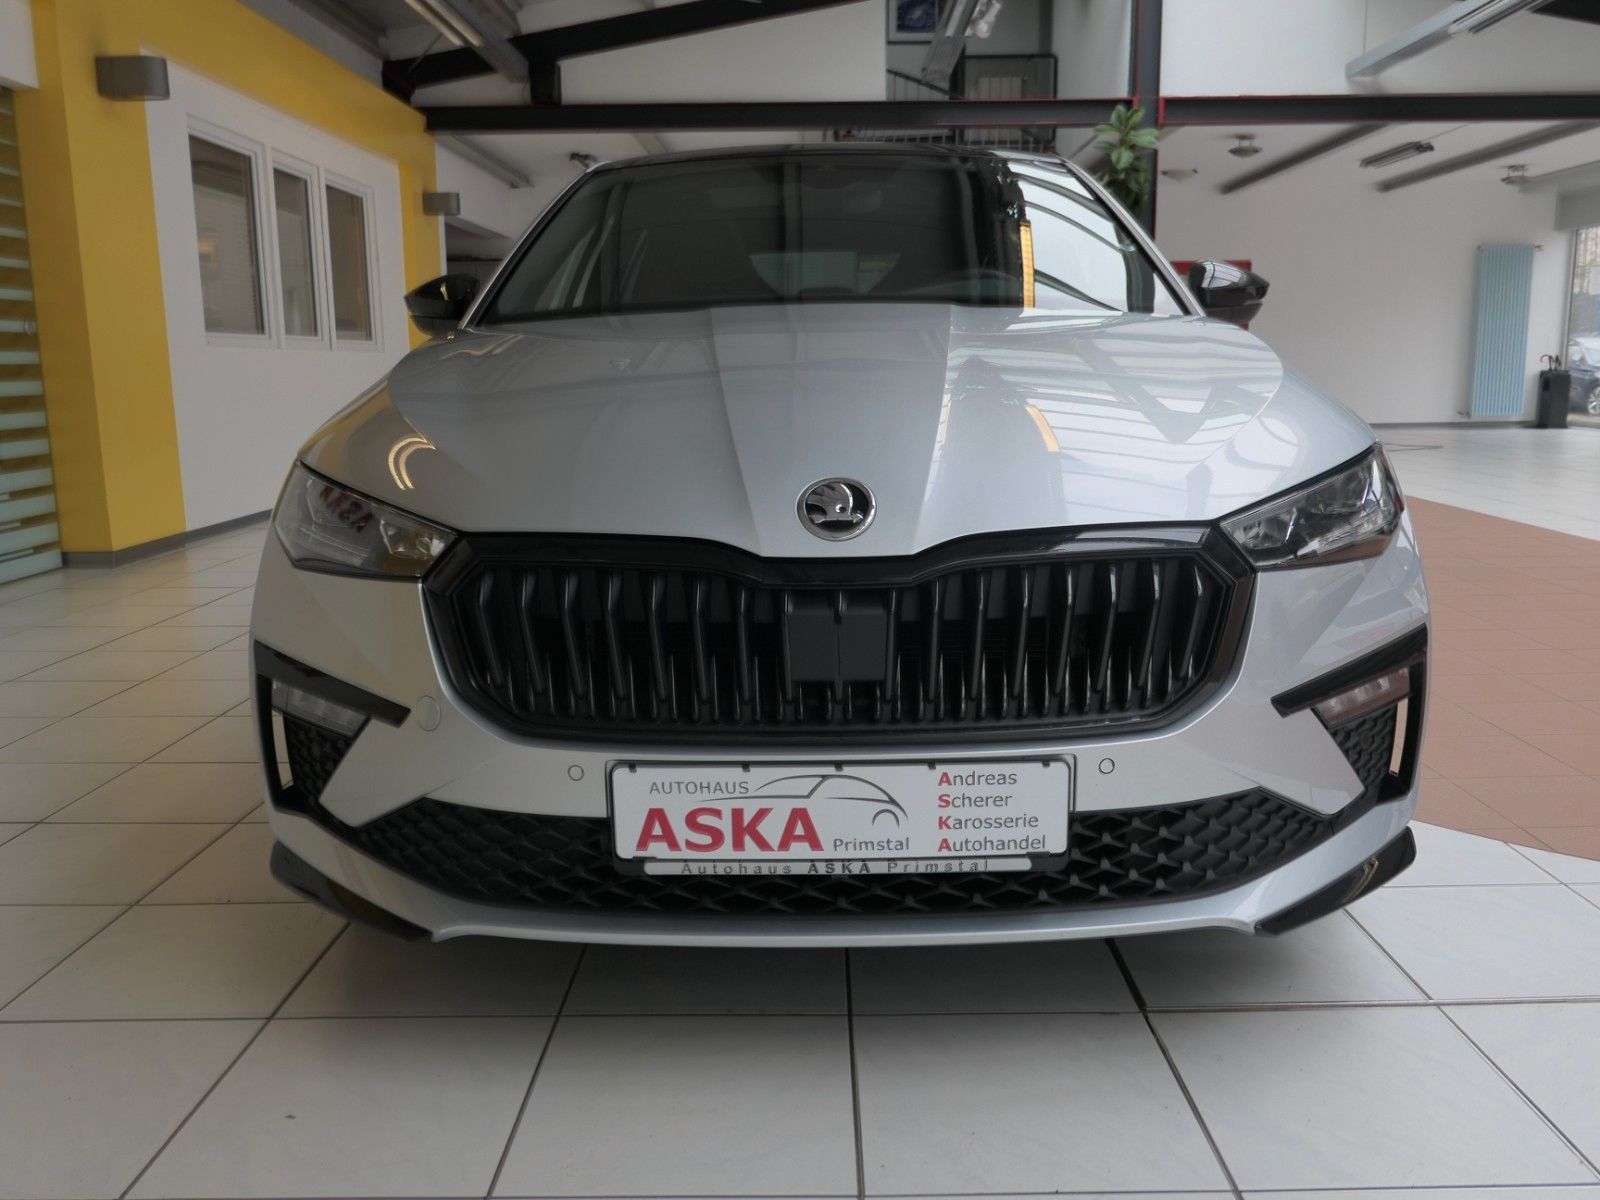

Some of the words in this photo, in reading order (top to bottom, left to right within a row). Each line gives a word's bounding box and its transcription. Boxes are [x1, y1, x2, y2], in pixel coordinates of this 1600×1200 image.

[938, 770, 1018, 786] Andreas
[649, 781, 750, 795] AUTOHAUS
[937, 793, 1013, 808] Scherer
[635, 806, 825, 852] ASKA
[833, 837, 910, 851] Primstal
[938, 813, 1039, 830] Karosserie
[938, 834, 1046, 852] Autohandel
[681, 859, 792, 875] Autohaus
[807, 859, 871, 874] ASKA
[887, 858, 989, 873] Primstal
